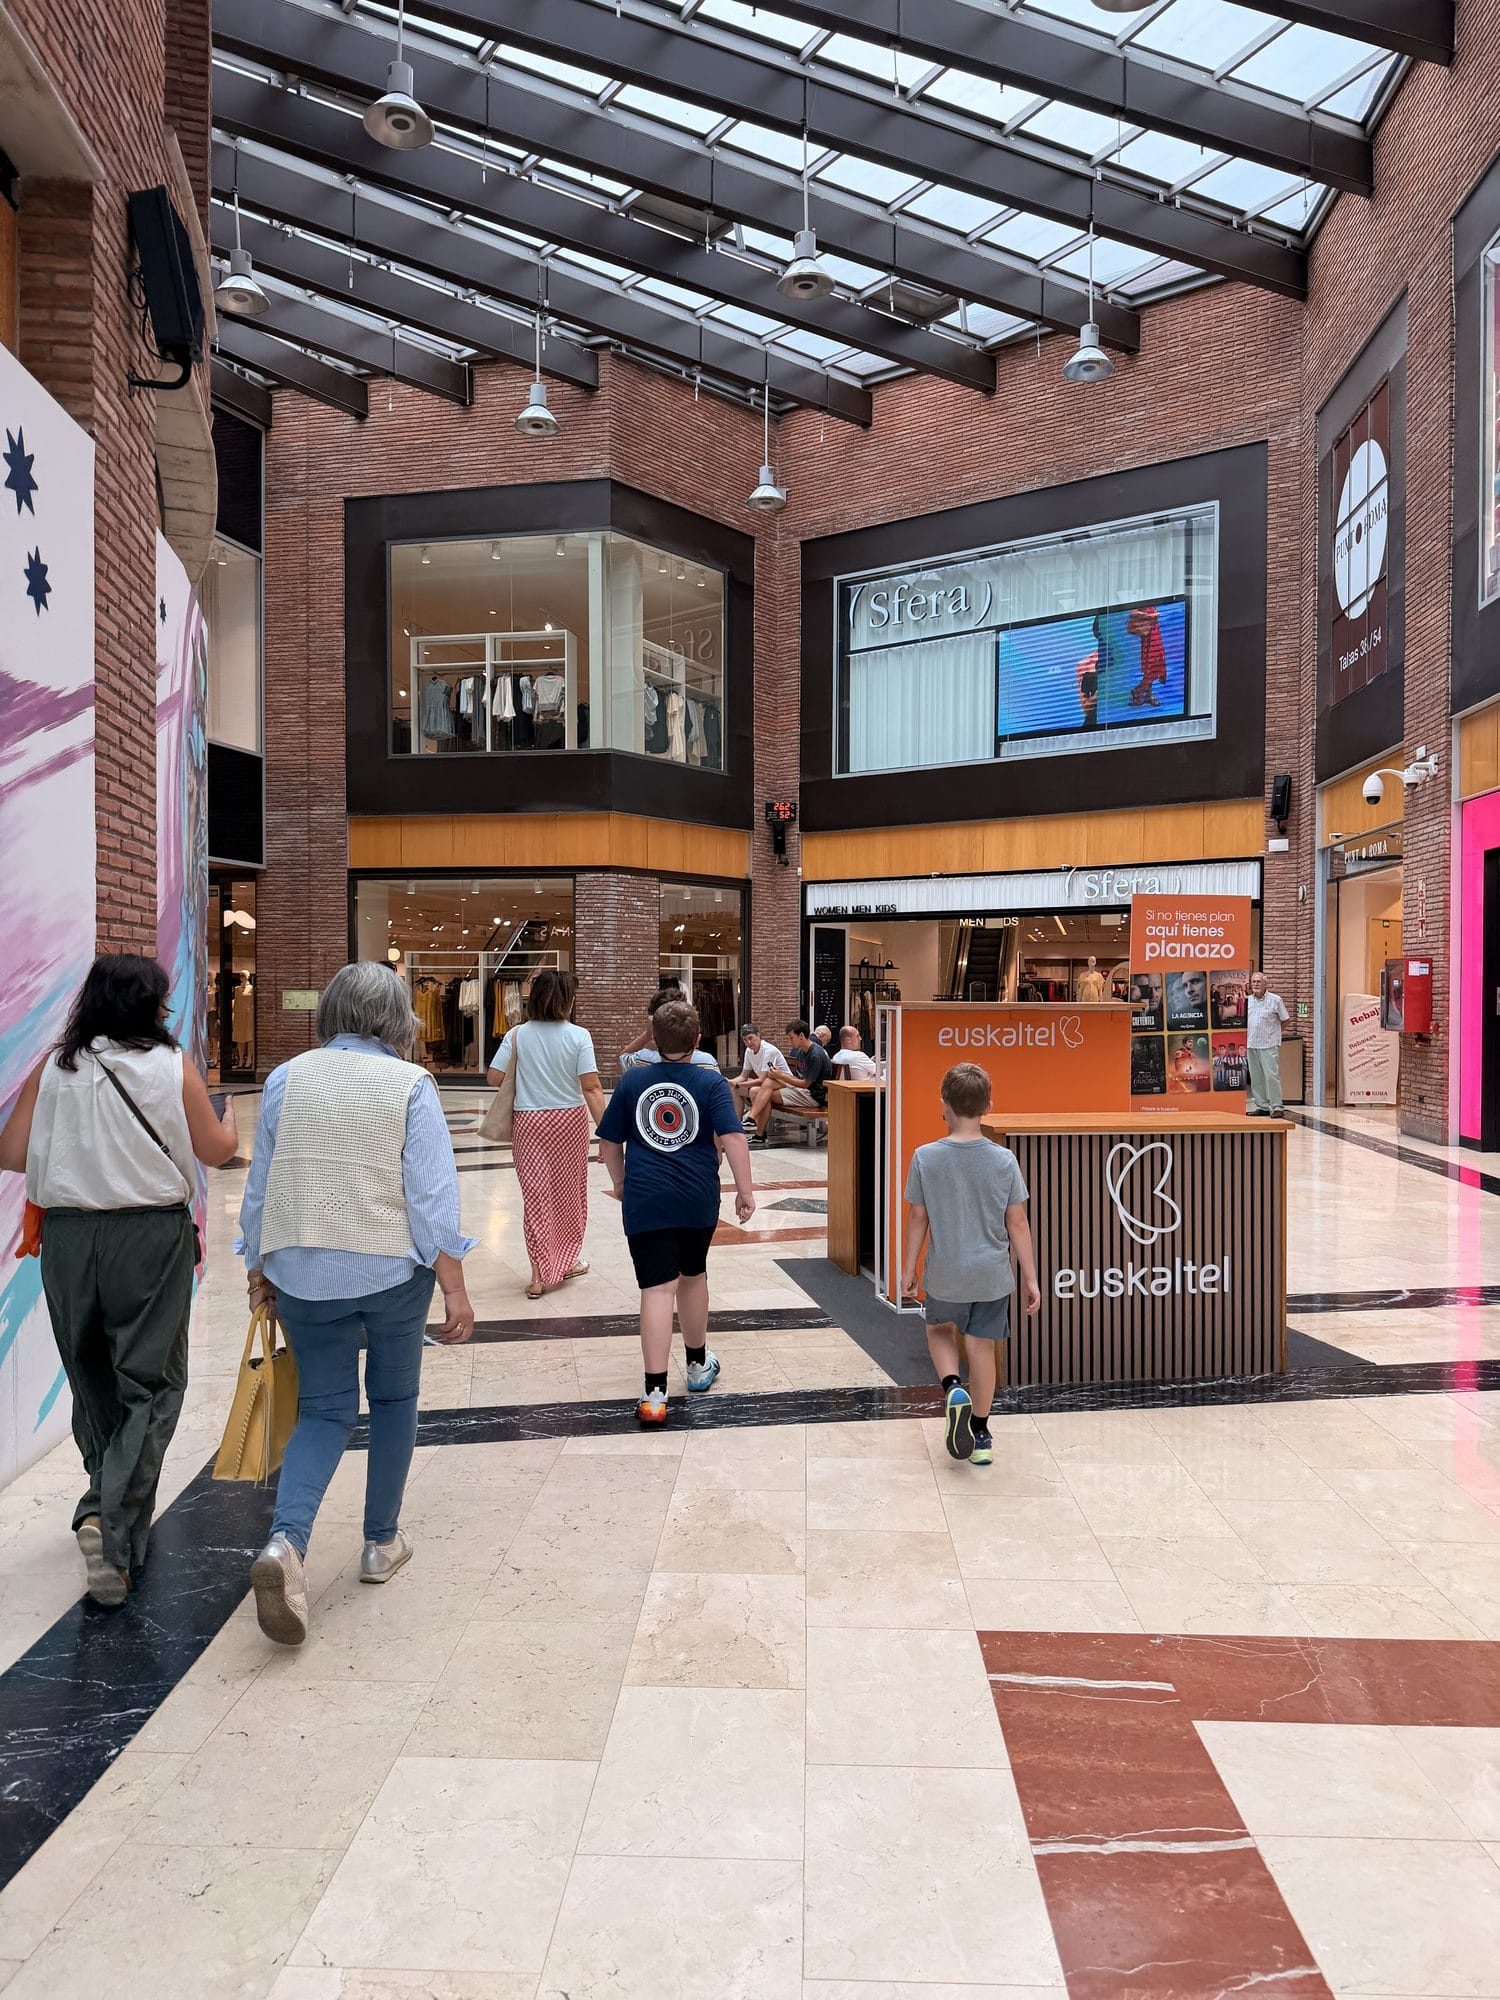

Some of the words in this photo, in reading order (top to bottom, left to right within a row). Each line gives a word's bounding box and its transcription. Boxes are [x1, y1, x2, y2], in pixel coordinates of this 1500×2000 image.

[814, 906, 848, 915] WOMEN
[852, 905, 872, 913] MEN
[875, 904, 897, 913] KIDS
[1146, 909, 1155, 920] Si
[1157, 912, 1172, 921] no
[1175, 911, 1207, 921] tienes
[1210, 911, 1235, 924] plan
[1146, 923, 1179, 938] aquí
[1182, 924, 1224, 937] tienes
[1145, 939, 1235, 961] planazo
[938, 1022, 1055, 1047] euskaltel
[648, 1090, 665, 1102] OLD
[667, 1090, 688, 1105] NAVY
[646, 1125, 669, 1145] SKATE
[1055, 1255, 1230, 1299] euskaltel
